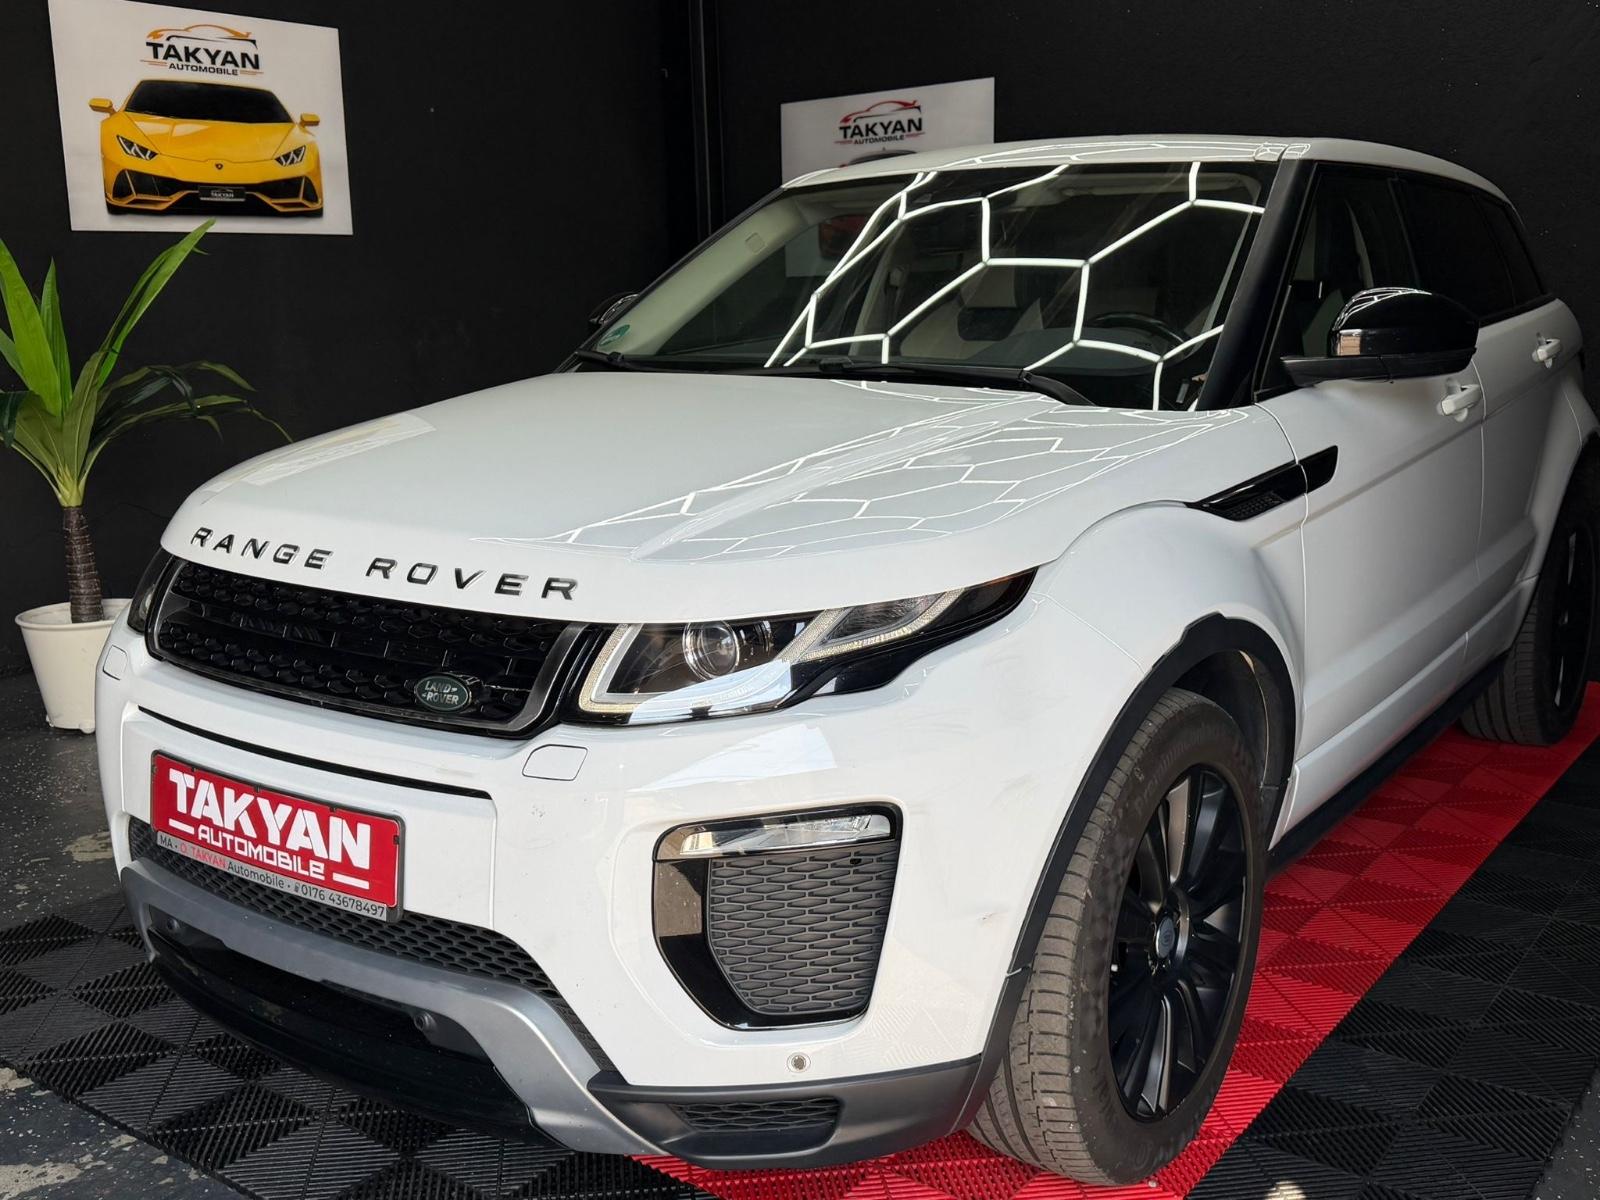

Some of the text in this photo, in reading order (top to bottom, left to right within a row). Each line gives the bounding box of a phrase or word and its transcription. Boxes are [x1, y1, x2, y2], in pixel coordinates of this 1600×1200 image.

[146, 41, 260, 70] TAKYAN
[168, 63, 238, 75] AUTOMOBILE
[839, 118, 922, 139] TAKYAN
[854, 134, 904, 144] AUTOMOBILE
[190, 527, 579, 600] RANGE ROVER
[169, 768, 371, 870] TAKYAN
[198, 826, 325, 880] AUTOMOBILE
[191, 846, 227, 869] TAKYAN
[227, 861, 285, 888] Automobile
[301, 884, 326, 901] 0176
[328, 894, 385, 918] 43678497
